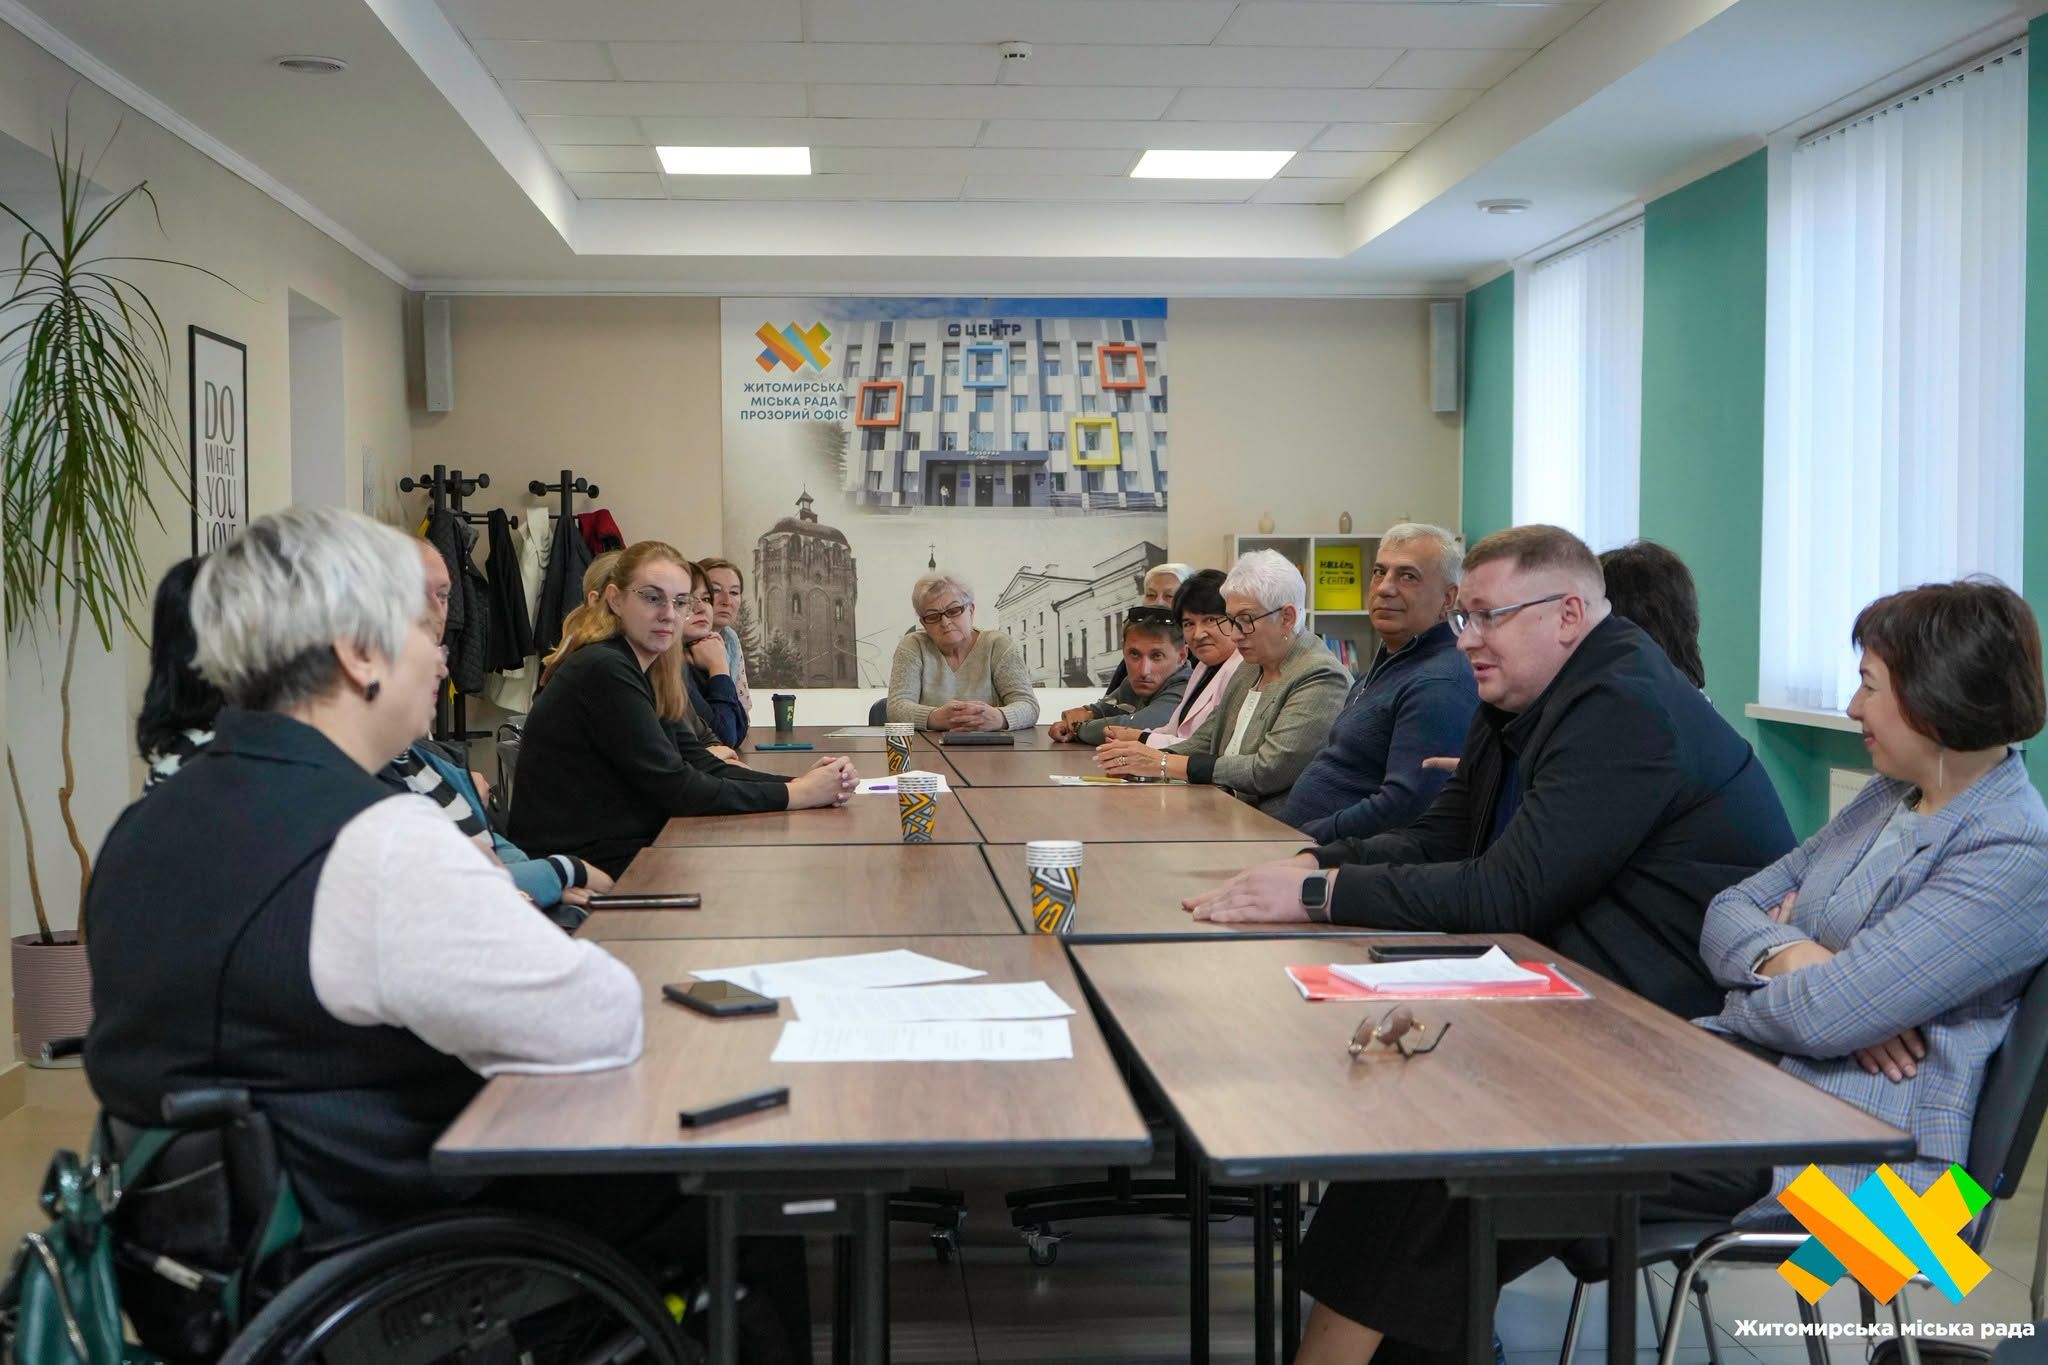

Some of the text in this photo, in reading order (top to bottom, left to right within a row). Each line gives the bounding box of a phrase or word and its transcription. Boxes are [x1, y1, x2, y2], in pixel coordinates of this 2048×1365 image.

[965, 323, 1022, 338] ЦЕНТР
[743, 383, 845, 393] ЖИТОМИРСЬКА
[750, 397, 838, 408] МІСЬКА РАДА
[204, 381, 235, 445] DO
[740, 408, 849, 421] ПРОЗОРИЙ ОФІС
[205, 443, 236, 477] WHAT
[206, 476, 237, 519] YOU
